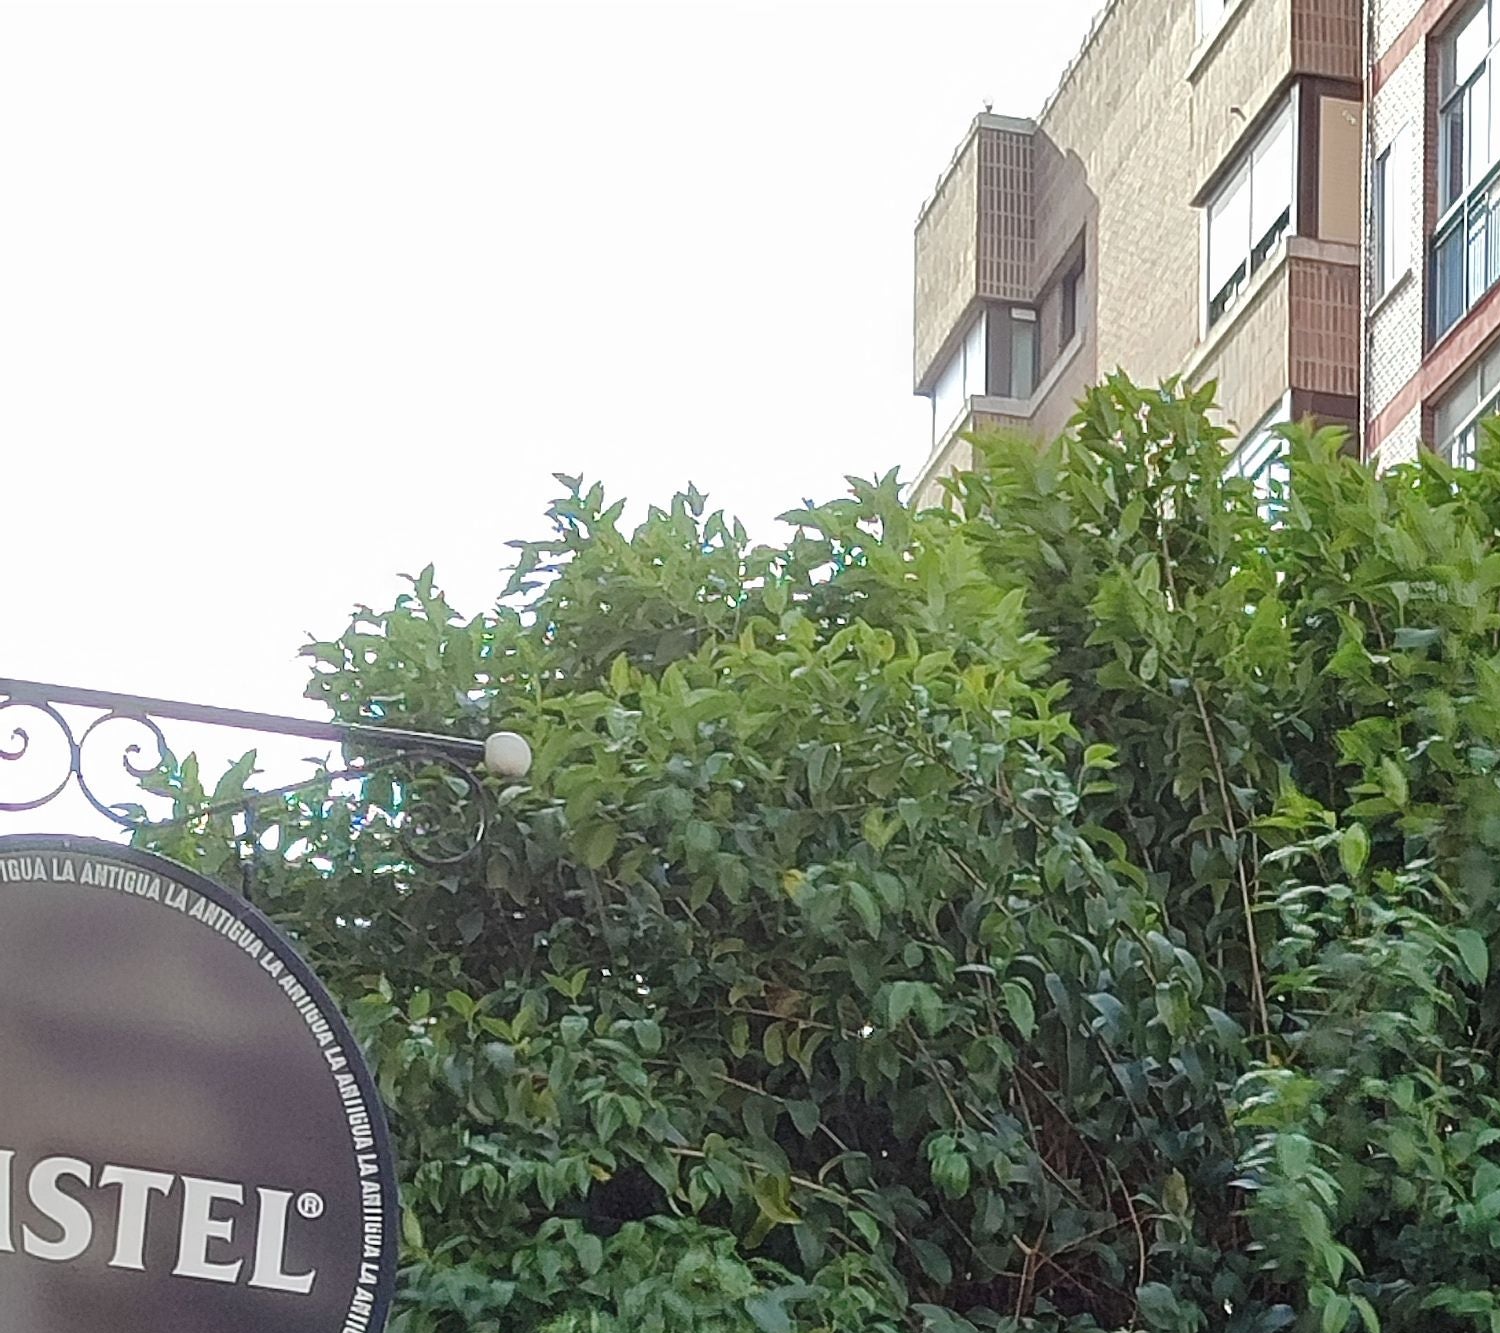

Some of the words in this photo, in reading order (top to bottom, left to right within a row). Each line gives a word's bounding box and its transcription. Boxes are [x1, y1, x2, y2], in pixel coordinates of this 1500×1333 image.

[52, 857, 75, 882] LA
[80, 860, 160, 901] ANTIGUA
[164, 883, 188, 912] LA
[188, 896, 265, 959] ANTIGUA
[259, 951, 286, 978] LA
[278, 974, 335, 1046] ANTIGUA
[324, 1046, 348, 1071] LA
[334, 1073, 374, 1150] ANTIGUA
[357, 1153, 380, 1177] LA
[361, 1180, 383, 1258] ANTIGUA
[358, 1262, 380, 1285] LA
